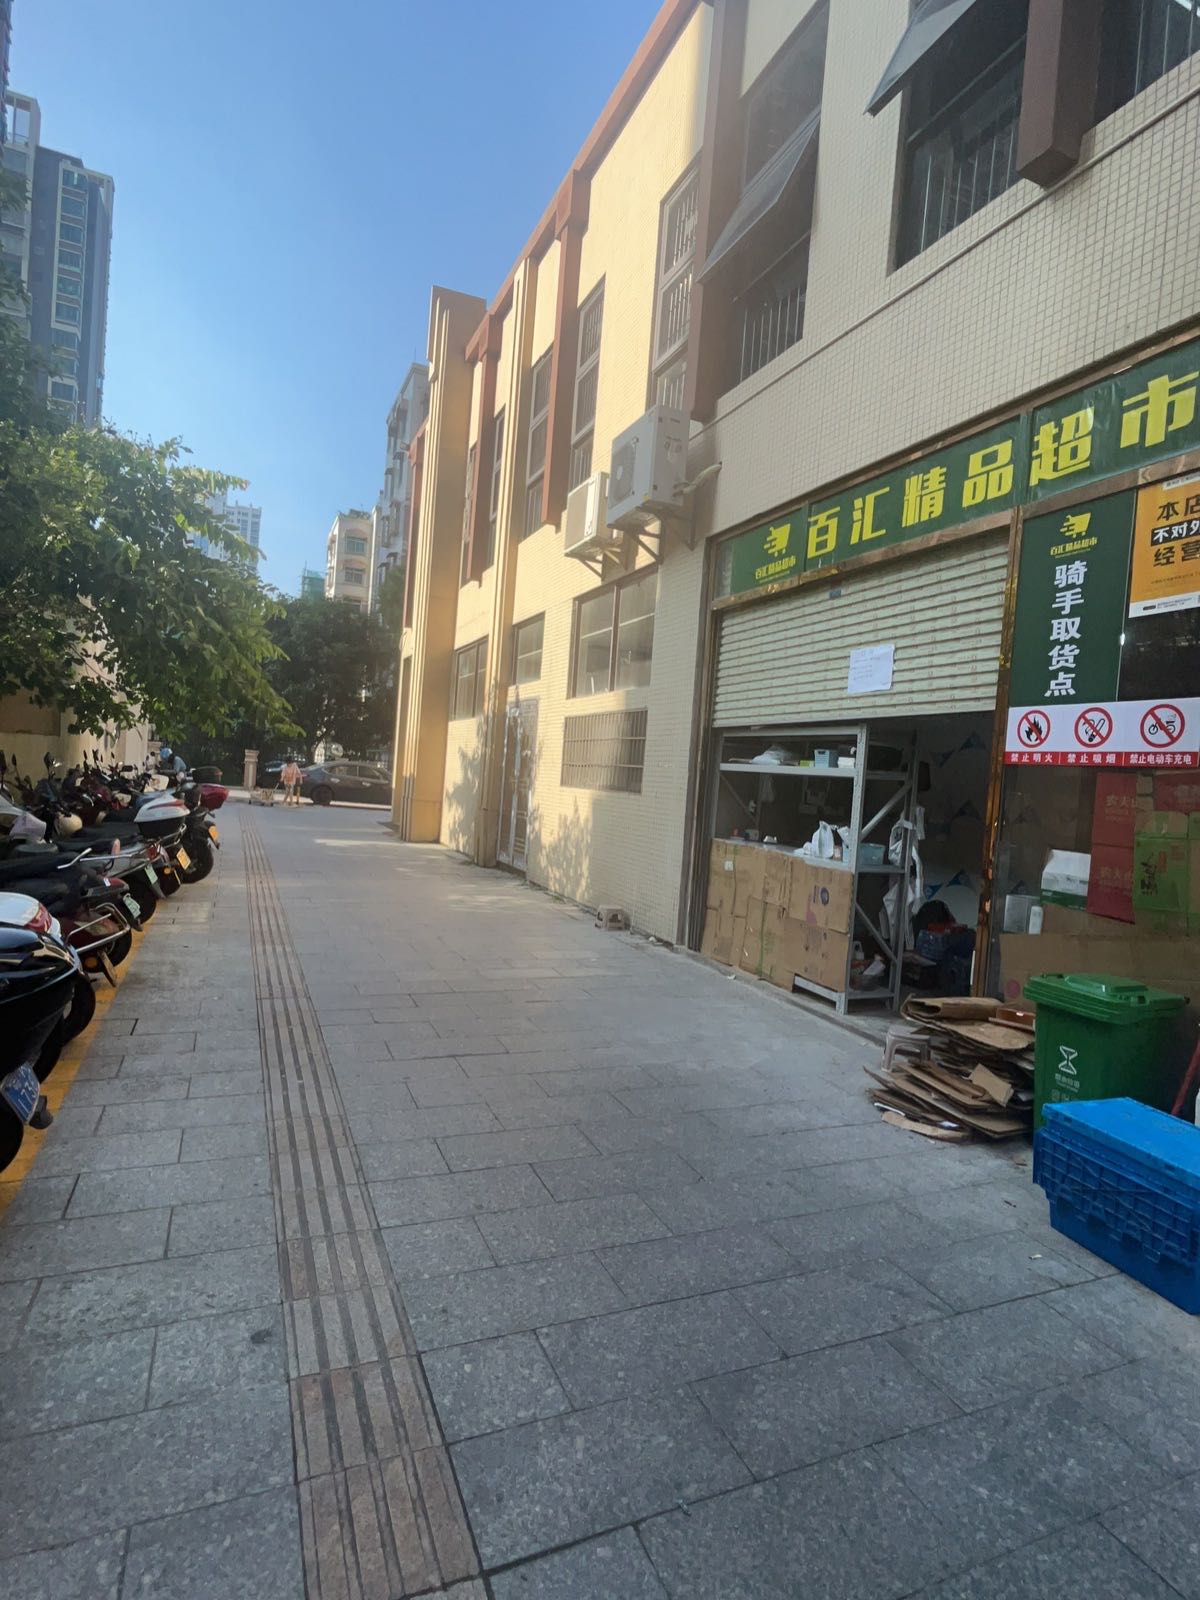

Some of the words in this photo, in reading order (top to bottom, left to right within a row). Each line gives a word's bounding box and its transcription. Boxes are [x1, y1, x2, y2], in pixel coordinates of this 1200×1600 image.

[806, 372, 1200, 559] 百汇精品超市
[1157, 495, 1200, 521] 本店
[1153, 541, 1200, 567] 经营
[1044, 560, 1088, 697] 骑手取货点
[1011, 753, 1053, 763] 禁止明火
[1067, 753, 1116, 764] 禁止吸烟
[1130, 753, 1192, 765] 禁止电动车充电
